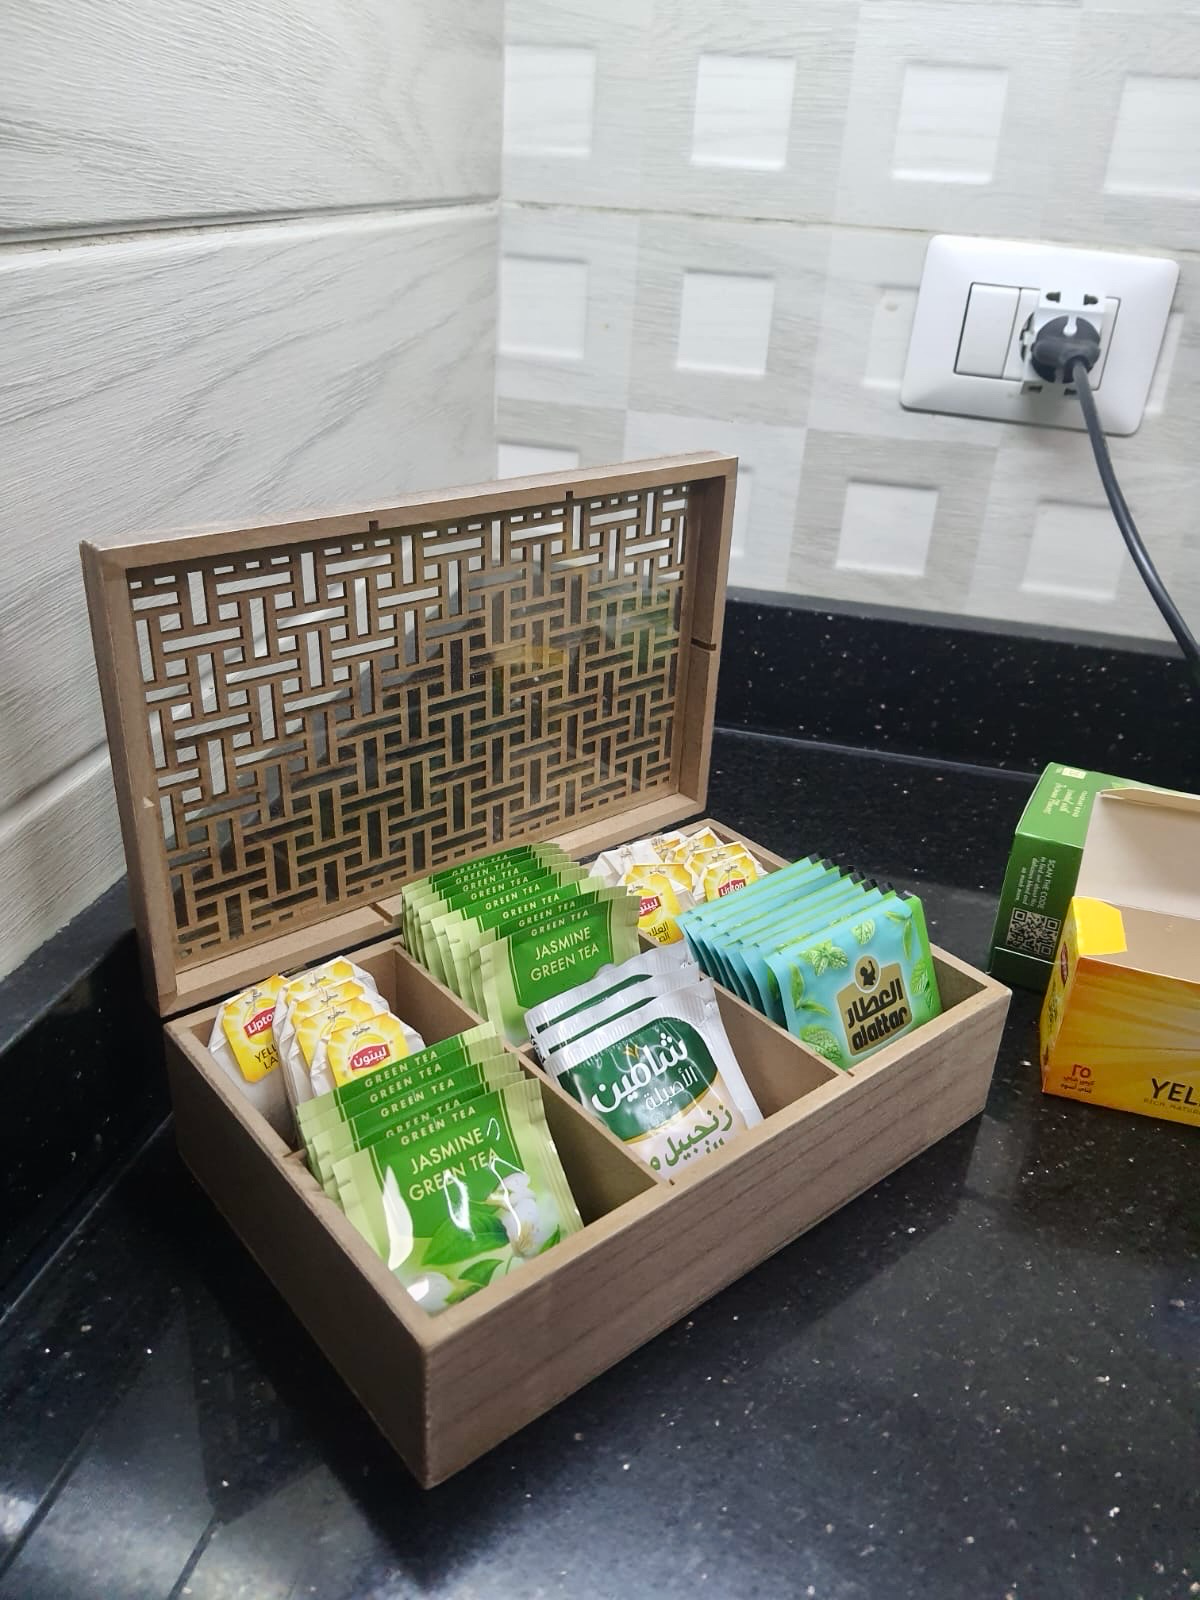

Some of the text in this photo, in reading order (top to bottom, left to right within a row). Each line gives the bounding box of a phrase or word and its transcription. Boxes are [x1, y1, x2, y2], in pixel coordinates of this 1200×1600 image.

[455, 861, 512, 885] GREEN TEA
[462, 867, 520, 892] GREEN TEA
[470, 876, 529, 900] GREEN TEA
[485, 883, 541, 910] GREEN TEA
[502, 893, 560, 919] GREEN TEA
[519, 901, 576, 927] GREEN TEA
[531, 910, 589, 937] GREEN TEA
[535, 926, 591, 961] JASMINE
[530, 943, 600, 981] GREEN TEA
[847, 978, 904, 1029] العطار
[247, 1011, 275, 1034] Lipto
[852, 1007, 907, 1050] alattar
[254, 1044, 277, 1063] YELL
[263, 1053, 279, 1070] LA
[353, 1045, 387, 1067] ليبتون
[365, 1050, 438, 1088] GREEN TEA
[369, 1063, 442, 1103] GREEN TEA
[592, 1033, 688, 1113] شامين
[644, 1066, 698, 1111] الأصيلة
[380, 1078, 455, 1117] GREEN TEA
[1151, 1077, 1200, 1106] YEL
[386, 1099, 461, 1138] GREEN TEA
[401, 1106, 476, 1146] GREEN TEA
[665, 1104, 733, 1166] زنجبيل
[411, 1128, 484, 1175] JASMINE
[409, 1147, 497, 1201] GREEN TEA
